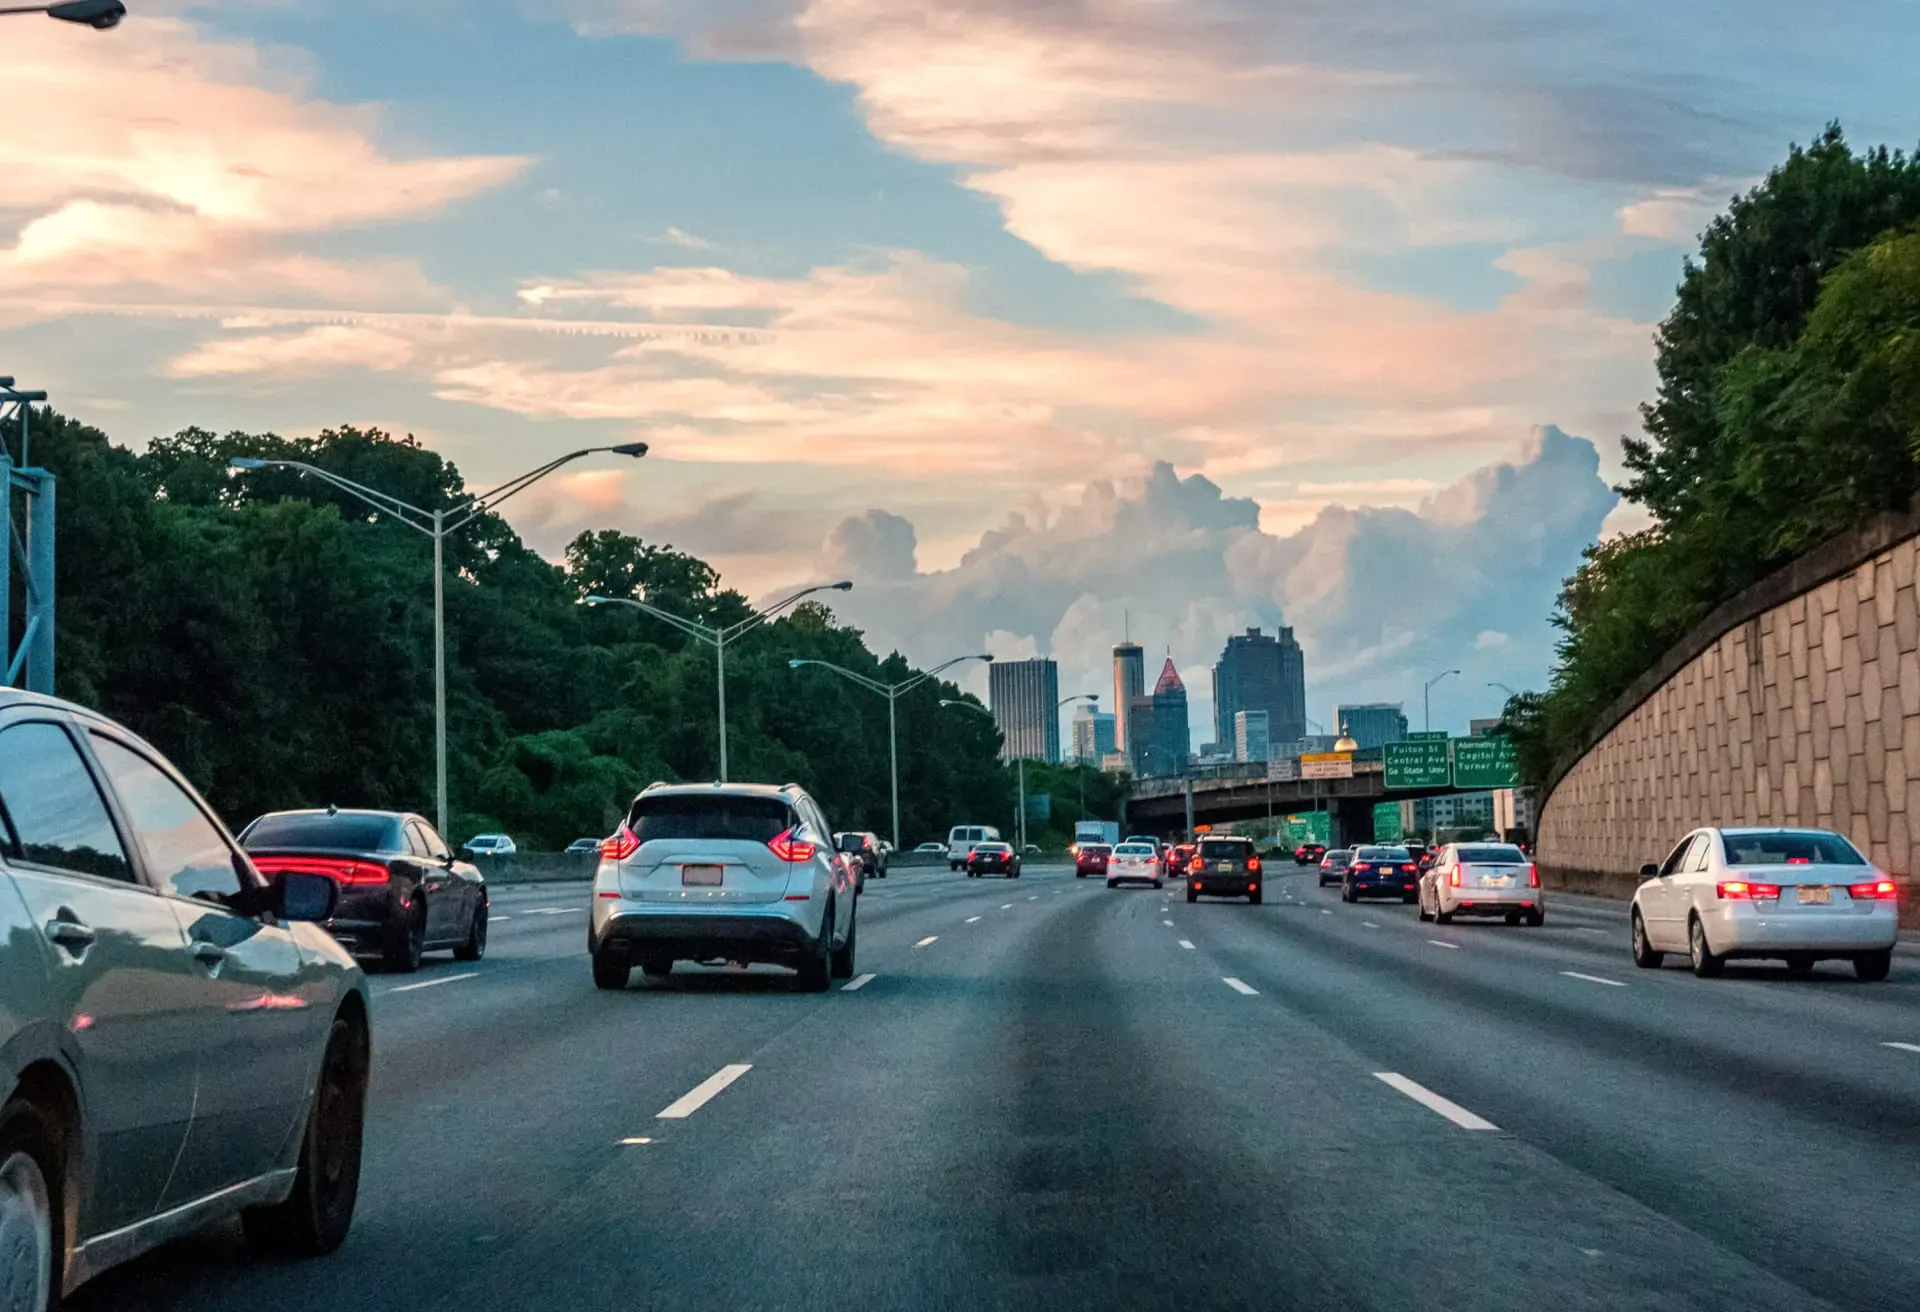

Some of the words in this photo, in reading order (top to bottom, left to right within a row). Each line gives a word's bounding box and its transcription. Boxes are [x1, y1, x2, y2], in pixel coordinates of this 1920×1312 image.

[1393, 745, 1424, 754] Fulton
[1428, 744, 1438, 753] St
[1457, 741, 1497, 750] Abernathy
[1387, 756, 1423, 765] Central
[1428, 756, 1445, 764] Ave
[1459, 751, 1494, 761] Capitol
[1458, 762, 1490, 770] Turner
[1388, 767, 1399, 776] Ga
[1404, 766, 1424, 775] State
[1428, 766, 1446, 774] Univ
